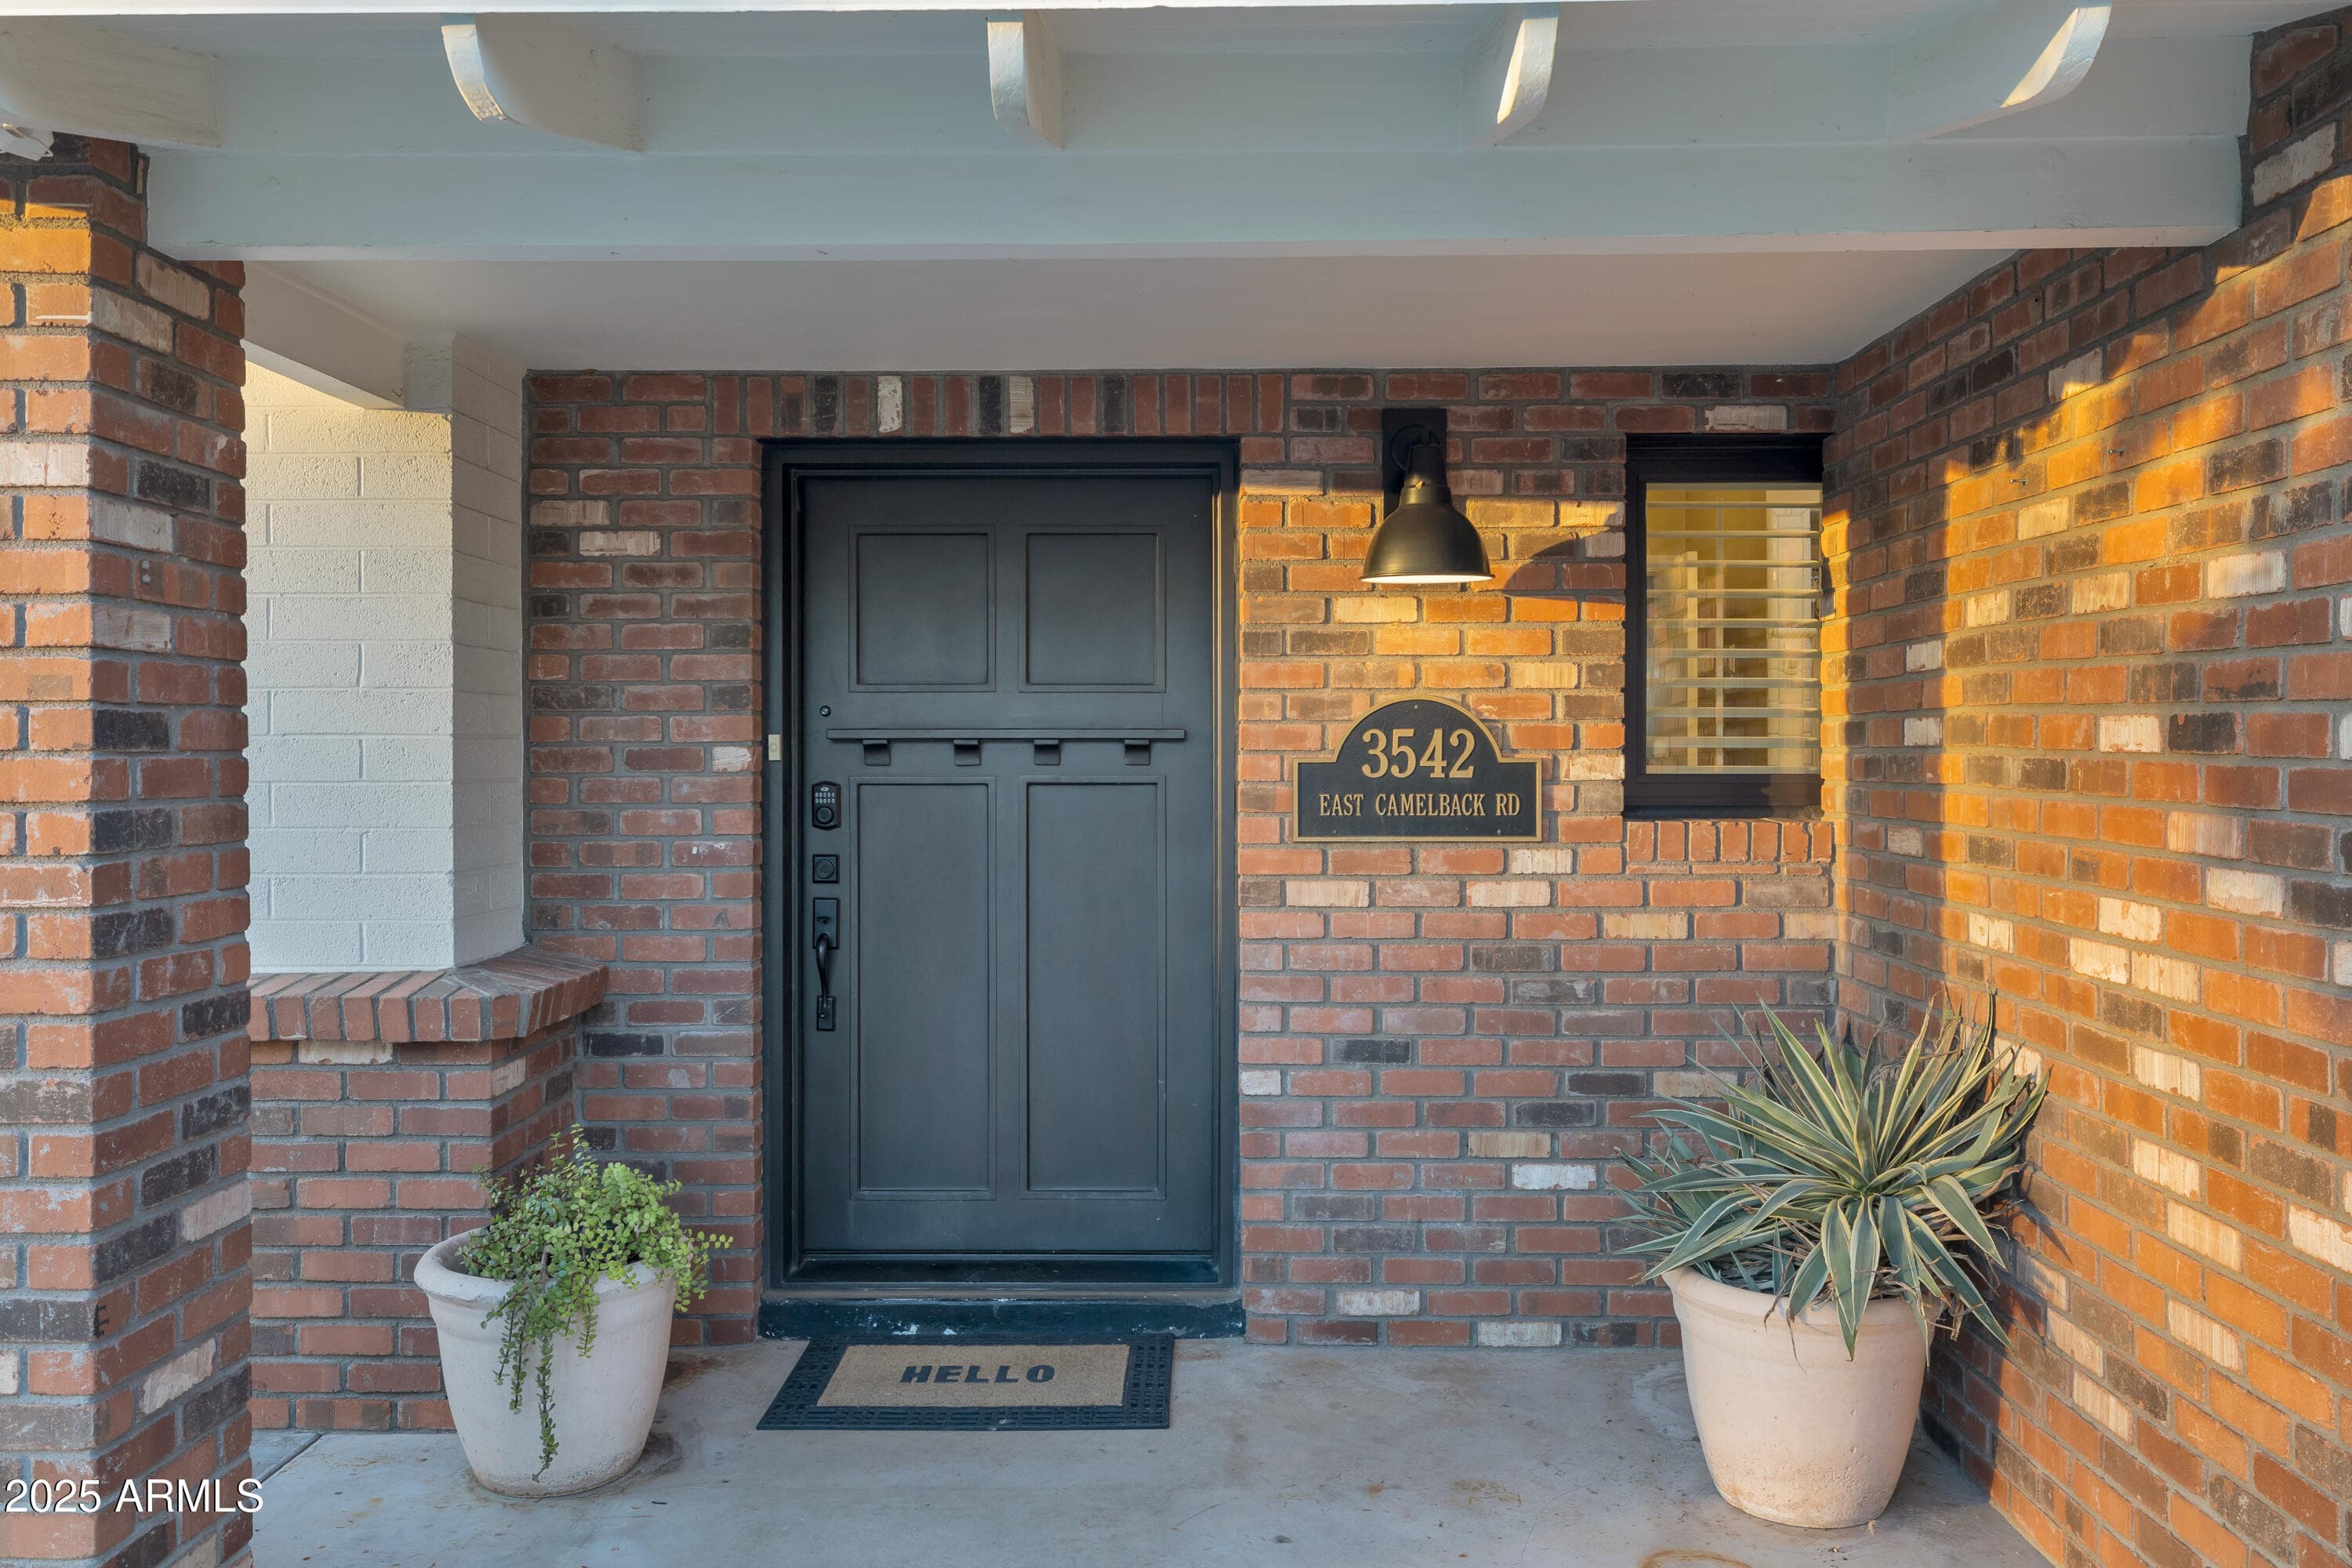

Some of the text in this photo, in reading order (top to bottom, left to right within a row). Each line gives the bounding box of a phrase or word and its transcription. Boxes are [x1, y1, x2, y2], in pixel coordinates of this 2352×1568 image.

[1362, 728, 1475, 779] 3542
[1319, 793, 1520, 816] EAST CAMELBACK RD
[899, 1364, 1055, 1383] HELLO
